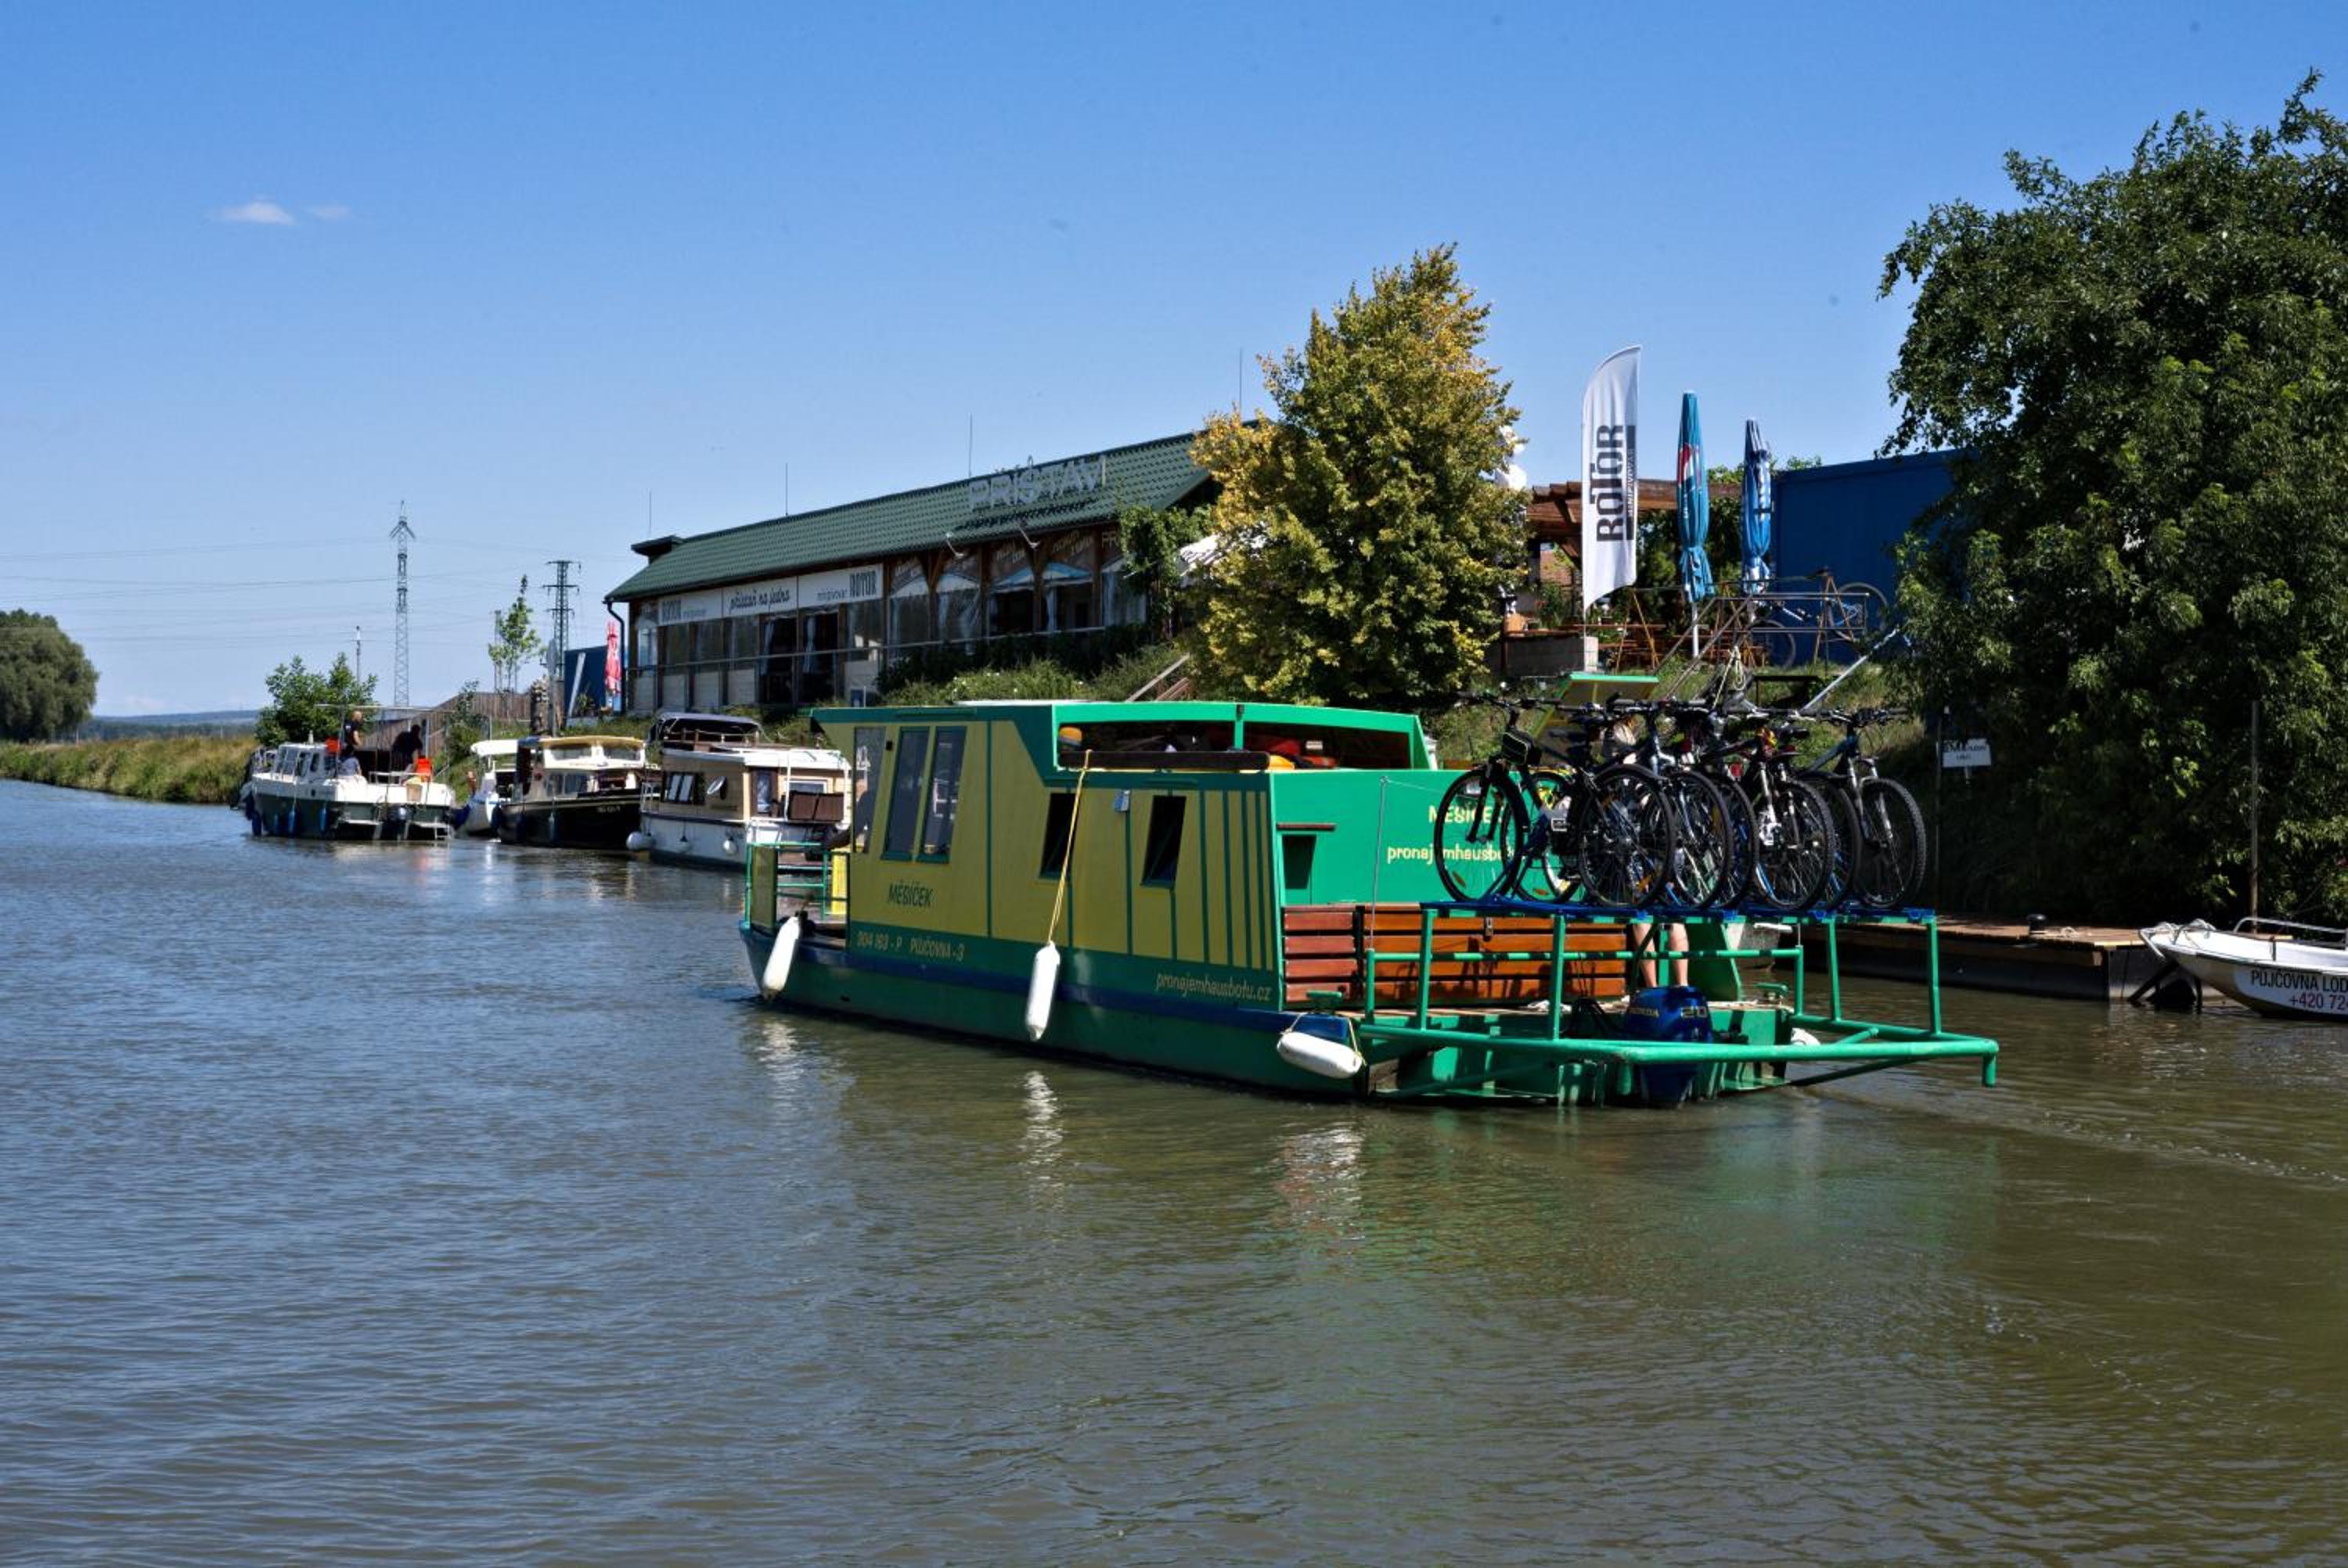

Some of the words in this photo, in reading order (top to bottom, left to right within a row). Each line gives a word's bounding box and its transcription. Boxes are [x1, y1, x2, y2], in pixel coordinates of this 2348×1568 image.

[1589, 425, 1624, 541] ROTOR
[1154, 972, 1273, 1002] pronajemhausbotu.cz
[2289, 991, 2324, 1009] +420
[2328, 994, 2348, 1010] 72
